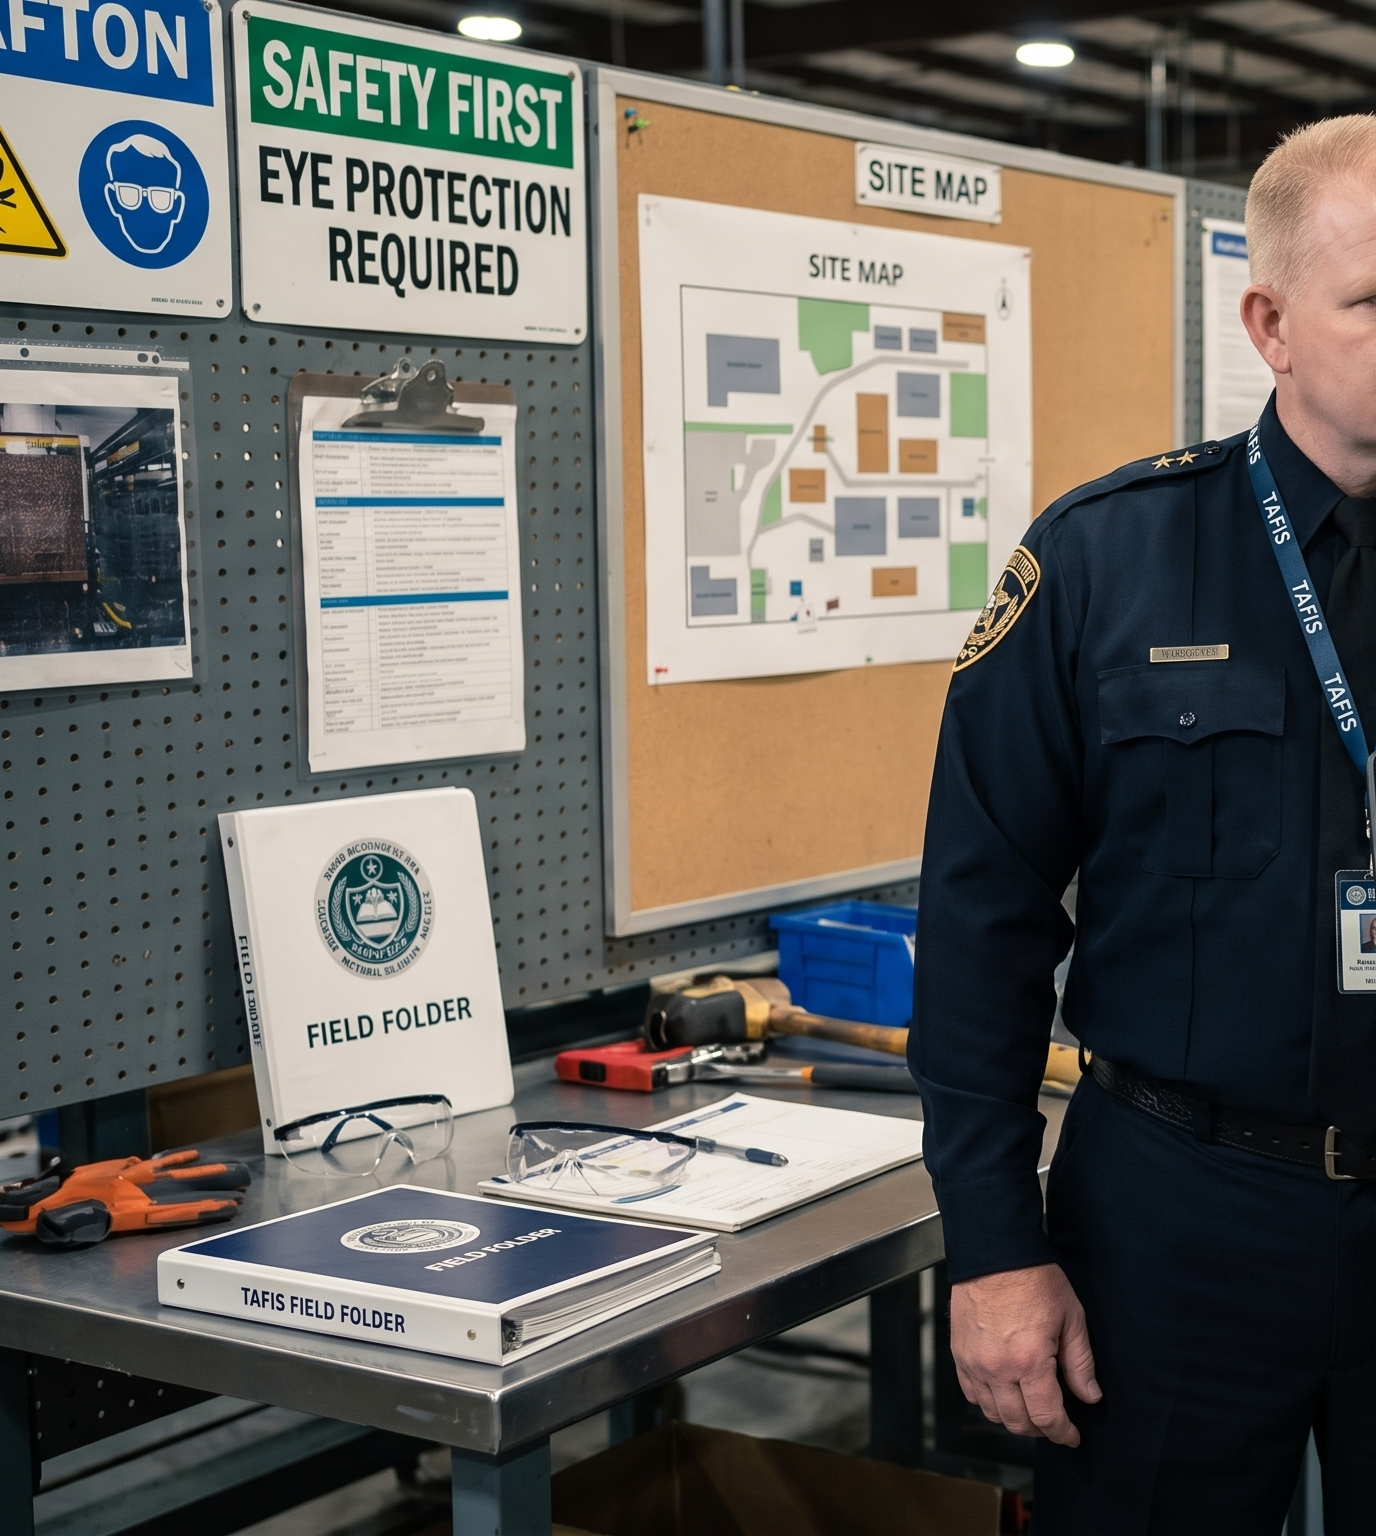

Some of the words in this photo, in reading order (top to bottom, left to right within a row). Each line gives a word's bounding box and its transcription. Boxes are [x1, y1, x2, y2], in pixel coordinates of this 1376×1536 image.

[262, 39, 436, 130] SAFETY
[448, 70, 562, 150] FIRST
[258, 145, 334, 210] EYE
[345, 157, 571, 237] PROTECTION
[869, 160, 926, 198] SITE
[935, 170, 987, 205] MAP
[328, 226, 519, 298] REQUIRED
[809, 254, 851, 281] SITE
[858, 260, 904, 287] MAP
[1248, 421, 1261, 465] AFIS
[1262, 491, 1290, 545] TAFIS
[1292, 579, 1322, 634] TAFIS
[1324, 672, 1357, 732] TAFIS
[238, 935, 253, 985] FIELD
[307, 1014, 374, 1049] FIELD
[382, 996, 473, 1034] FOLDER
[424, 1249, 488, 1272] FIELD
[481, 1228, 562, 1252] FOLDER
[241, 1286, 285, 1312] TAFIS
[290, 1295, 335, 1320] FIELD
[340, 1304, 406, 1333] FOLDER
